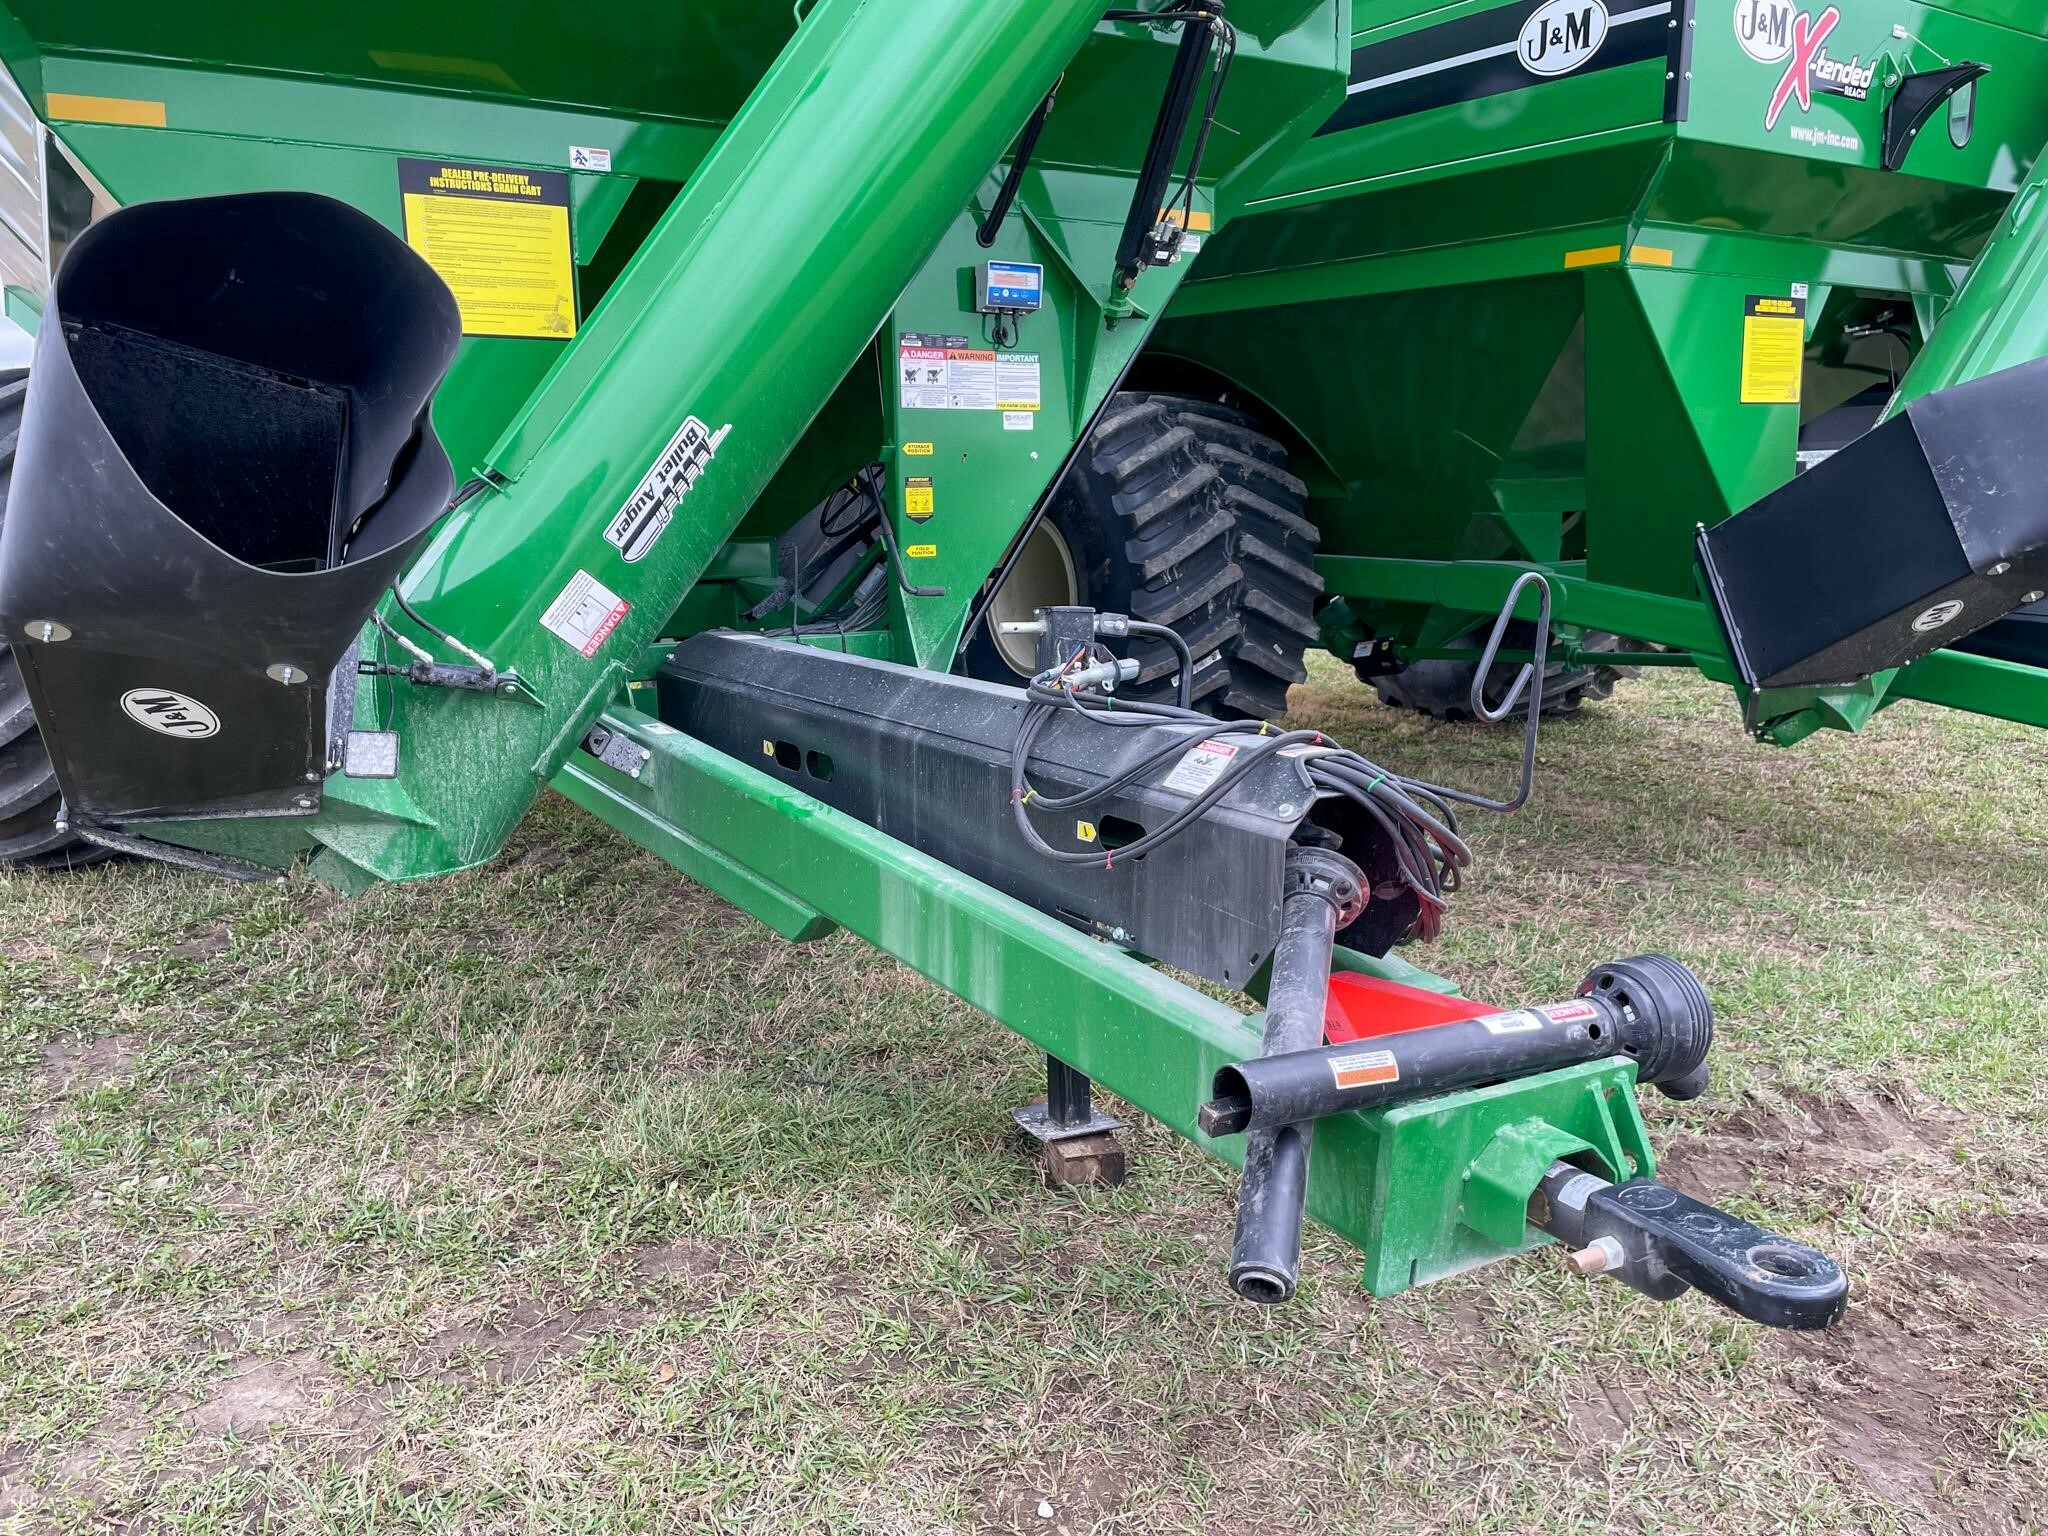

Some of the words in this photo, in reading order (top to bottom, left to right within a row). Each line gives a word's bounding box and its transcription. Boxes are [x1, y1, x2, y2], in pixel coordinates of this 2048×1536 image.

[1526, 6, 1593, 61] J&M
[1741, 0, 1790, 48] J&M
[1844, 86, 1867, 99] REACH
[1790, 125, 1858, 150] www.jm-inc.com
[430, 176, 492, 192] INSTRUCTIONS
[493, 182, 519, 194] GRAIN
[520, 185, 542, 196] CART
[441, 167, 473, 181] DEALER
[473, 170, 529, 185] PRE-DELIVERY
[910, 350, 944, 359] DANGER
[958, 352, 993, 361] WARNING
[996, 354, 1039, 363] IMPORTANT
[655, 426, 699, 484] Bullet
[613, 483, 655, 542] Auger
[1920, 604, 1957, 628] J&M
[584, 611, 621, 655] DANGER
[131, 695, 210, 734] J&M
[1547, 1005, 1581, 1018] DANGER
